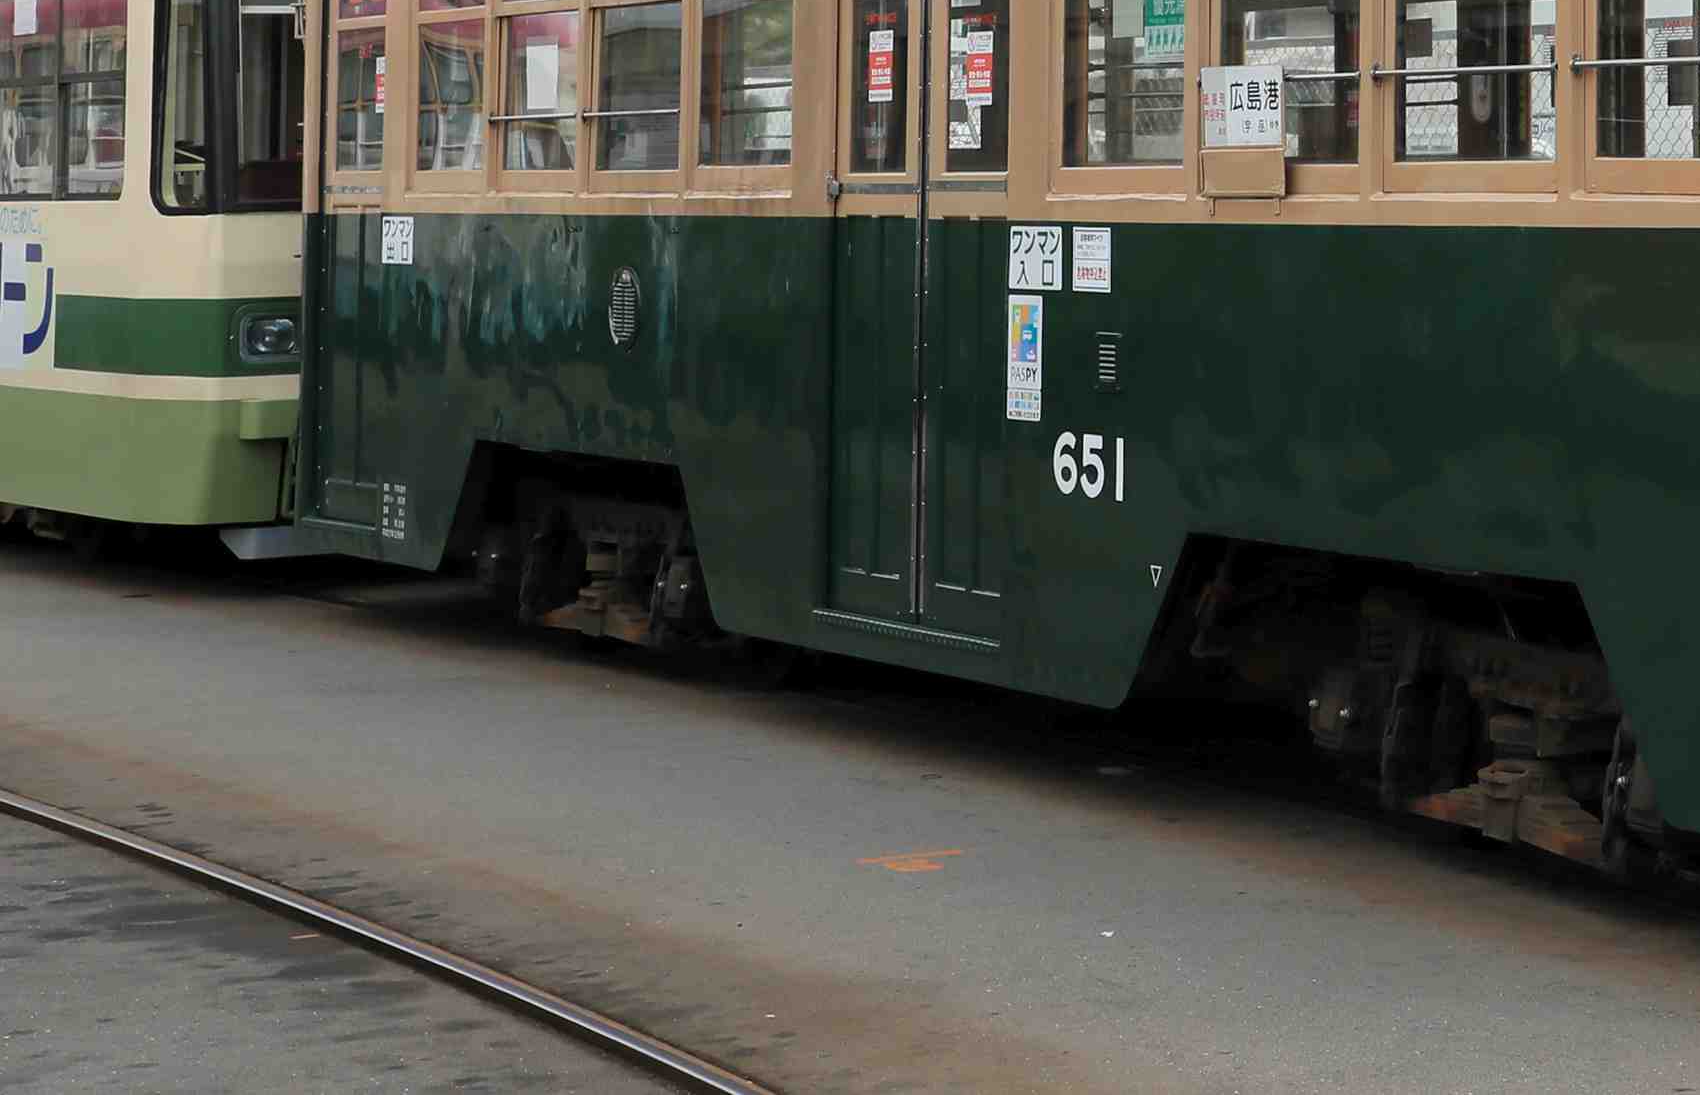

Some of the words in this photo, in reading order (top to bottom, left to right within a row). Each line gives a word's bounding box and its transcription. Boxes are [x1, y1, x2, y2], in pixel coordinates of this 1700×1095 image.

[1229, 79, 1280, 112] 広島港
[384, 219, 413, 238] ワンマン
[1012, 230, 1061, 255] ワンマン
[1016, 259, 1055, 286] 入口
[1010, 365, 1038, 383] PASPY
[1053, 431, 1124, 502] 651
